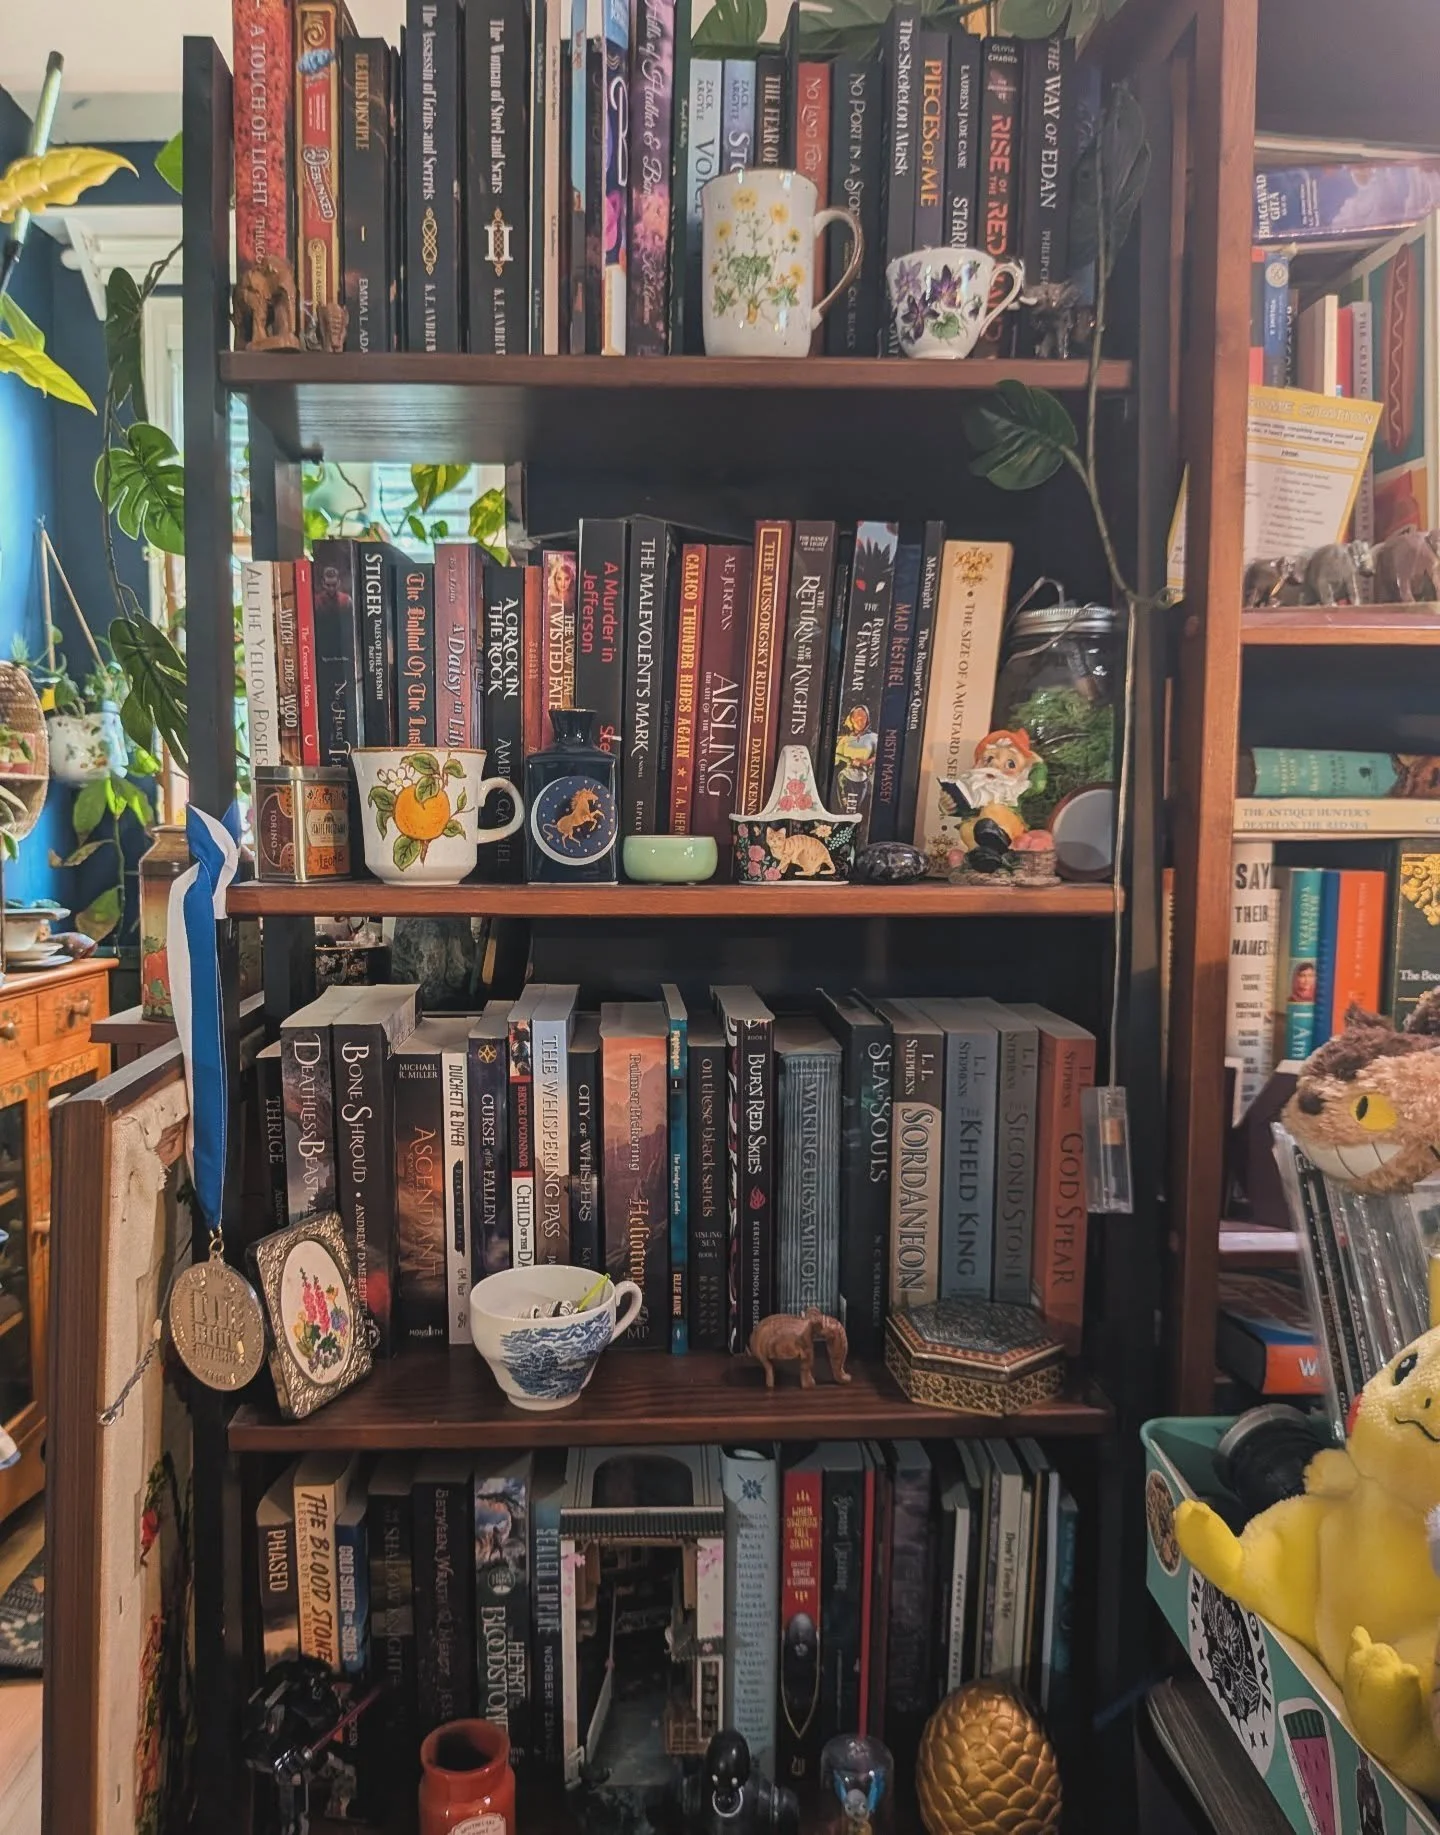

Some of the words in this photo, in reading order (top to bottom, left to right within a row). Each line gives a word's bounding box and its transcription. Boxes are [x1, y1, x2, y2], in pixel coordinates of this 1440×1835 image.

[250, 42, 266, 109] TOUCH
[489, 43, 506, 88] Woman
[849, 73, 866, 97] NO
[421, 83, 438, 98] of
[489, 89, 505, 104] of
[704, 79, 715, 109] ZACK
[764, 74, 781, 105] THE
[895, 53, 912, 128] Skeleton
[922, 59, 943, 142] PIECES
[958, 64, 970, 110] LAUREN
[1043, 74, 1062, 120] WAY
[250, 115, 266, 143] OF
[489, 104, 505, 137] Steel
[763, 108, 780, 146] FEAR
[848, 100, 867, 141] PORT
[1044, 123, 1058, 146] OF
[421, 132, 437, 155] and
[489, 136, 506, 158] and
[762, 149, 779, 166] OF
[893, 130, 911, 177] Mask
[956, 140, 967, 169] CASE
[989, 114, 1012, 173] RISE
[251, 148, 267, 207] LIGHT
[489, 160, 505, 195] Scars
[848, 162, 863, 176] A
[919, 166, 940, 208] ME
[1040, 148, 1059, 209] EDAN
[985, 200, 1008, 254] RED
[358, 278, 373, 315] EMMA
[1359, 311, 1368, 336] THE
[1359, 343, 1368, 395] CRYING
[604, 562, 618, 575] A
[640, 537, 656, 571] THE
[762, 542, 776, 572] THE
[246, 567, 264, 600] ALL
[364, 552, 384, 617] STIGER
[405, 572, 426, 601] The
[683, 554, 700, 600] CALICO
[921, 555, 937, 609] McKnight
[247, 606, 262, 632] THE
[581, 569, 599, 653] Jefferson
[601, 579, 619, 643] Murder
[793, 575, 822, 645] RETURN
[816, 590, 825, 609] THE
[893, 603, 912, 631] MAD
[962, 603, 976, 628] THE
[280, 608, 297, 645] WITCH
[300, 627, 310, 642] The
[374, 617, 383, 639] TALES
[404, 605, 427, 652] Ballad
[452, 620, 466, 634] A
[549, 600, 565, 674] TWISTED
[564, 613, 574, 640] THE
[636, 573, 654, 698] MALEVOLENT'S
[680, 605, 697, 669] THUNDER
[756, 575, 773, 668] MUSSORGSKY
[917, 628, 929, 649] The
[249, 639, 267, 705] YELLOW
[282, 659, 296, 684] EDGE
[301, 644, 311, 680] Crescent
[374, 652, 382, 667] THE
[442, 635, 466, 696] Daisy
[564, 643, 574, 666] VOW
[602, 647, 616, 662] in
[797, 644, 805, 663] THE
[804, 647, 811, 660] OF
[887, 637, 910, 688] KESTREL
[957, 660, 969, 679] OF
[302, 683, 312, 708] Moon
[374, 667, 384, 700] SEVENTH
[563, 669, 574, 697] THAT
[678, 673, 695, 712] RIDES
[752, 670, 768, 723] RIDDLE
[789, 663, 812, 735] KNIGHTS
[956, 680, 967, 689] A
[279, 693, 298, 728] WOOD
[453, 700, 465, 714] in
[909, 698, 922, 730] Quota
[948, 691, 967, 756] MUSTARD
[251, 709, 270, 766] POSIES
[631, 702, 650, 757] MARK
[676, 717, 691, 758] AGAIN
[706, 672, 739, 797] AISLING
[882, 729, 898, 760] MISTY
[750, 738, 762, 778] DARIN
[675, 798, 687, 808] A.
[676, 785, 688, 794] T.
[879, 763, 895, 804] MASSEY
[635, 800, 644, 832] RIPLEY
[1240, 808, 1262, 818] THE
[1234, 862, 1271, 891] SAY
[1234, 904, 1268, 923] THEIR
[1231, 939, 1267, 956] NAMES
[1400, 969, 1419, 981] The
[541, 1035, 558, 1074] THE
[1290, 1025, 1313, 1058] Am
[341, 1042, 370, 1101] BONE
[399, 1063, 437, 1071] MICHAEL
[409, 1071, 439, 1079] MILLER
[629, 1053, 642, 1103] Palmer
[700, 1058, 713, 1079] on
[745, 1053, 765, 1098] BURN
[867, 1042, 891, 1086] SEA
[903, 1039, 918, 1095] STEPHENS
[449, 1064, 465, 1107] DUCKETT
[517, 1085, 527, 1115] BRYCE
[578, 1084, 591, 1119] CITY
[701, 1083, 715, 1124] these
[266, 1096, 284, 1164] THRICE
[451, 1121, 465, 1146] DYER
[481, 1094, 495, 1146] CURSE
[579, 1122, 588, 1137] OF
[749, 1100, 765, 1132] RED
[801, 1082, 819, 1166] WAKING
[341, 1103, 372, 1183] SHROUD
[518, 1117, 528, 1168] O'CONNOR
[542, 1078, 560, 1198] WHISPERING
[628, 1106, 642, 1171] Pickering
[701, 1127, 715, 1171] black
[747, 1134, 767, 1175] SKIES
[869, 1099, 891, 1184] SOULS
[959, 1119, 983, 1202] KHELD
[1059, 1132, 1084, 1201] GOD
[483, 1170, 496, 1225] FALLEN
[579, 1139, 592, 1222] WHISPERS
[701, 1172, 714, 1217] sands
[801, 1170, 818, 1217] URSA
[898, 1108, 934, 1291] SORDANEON
[517, 1184, 532, 1227] CHILD
[541, 1203, 560, 1238] PASS
[355, 1204, 365, 1249] ANDREW
[752, 1221, 760, 1254] KERSTIN
[956, 1212, 980, 1277] KING
[801, 1220, 817, 1292] MINOR
[1052, 1205, 1082, 1288] SPEAR
[672, 1273, 682, 1293] ELLIE
[752, 1259, 760, 1297] ESPINOSA
[298, 1502, 308, 1558] LEGENDS
[301, 1493, 328, 1531] THE
[434, 1489, 449, 1551] BETWEEN
[267, 1530, 288, 1591] PHASED
[300, 1563, 308, 1576] OF
[310, 1535, 331, 1603] BLOOD
[535, 1528, 559, 1577] SEALED
[301, 1584, 310, 1607] THE
[311, 1606, 333, 1663] STONE
[507, 1641, 525, 1697] HEART
[543, 1645, 553, 1705] NORBERT
